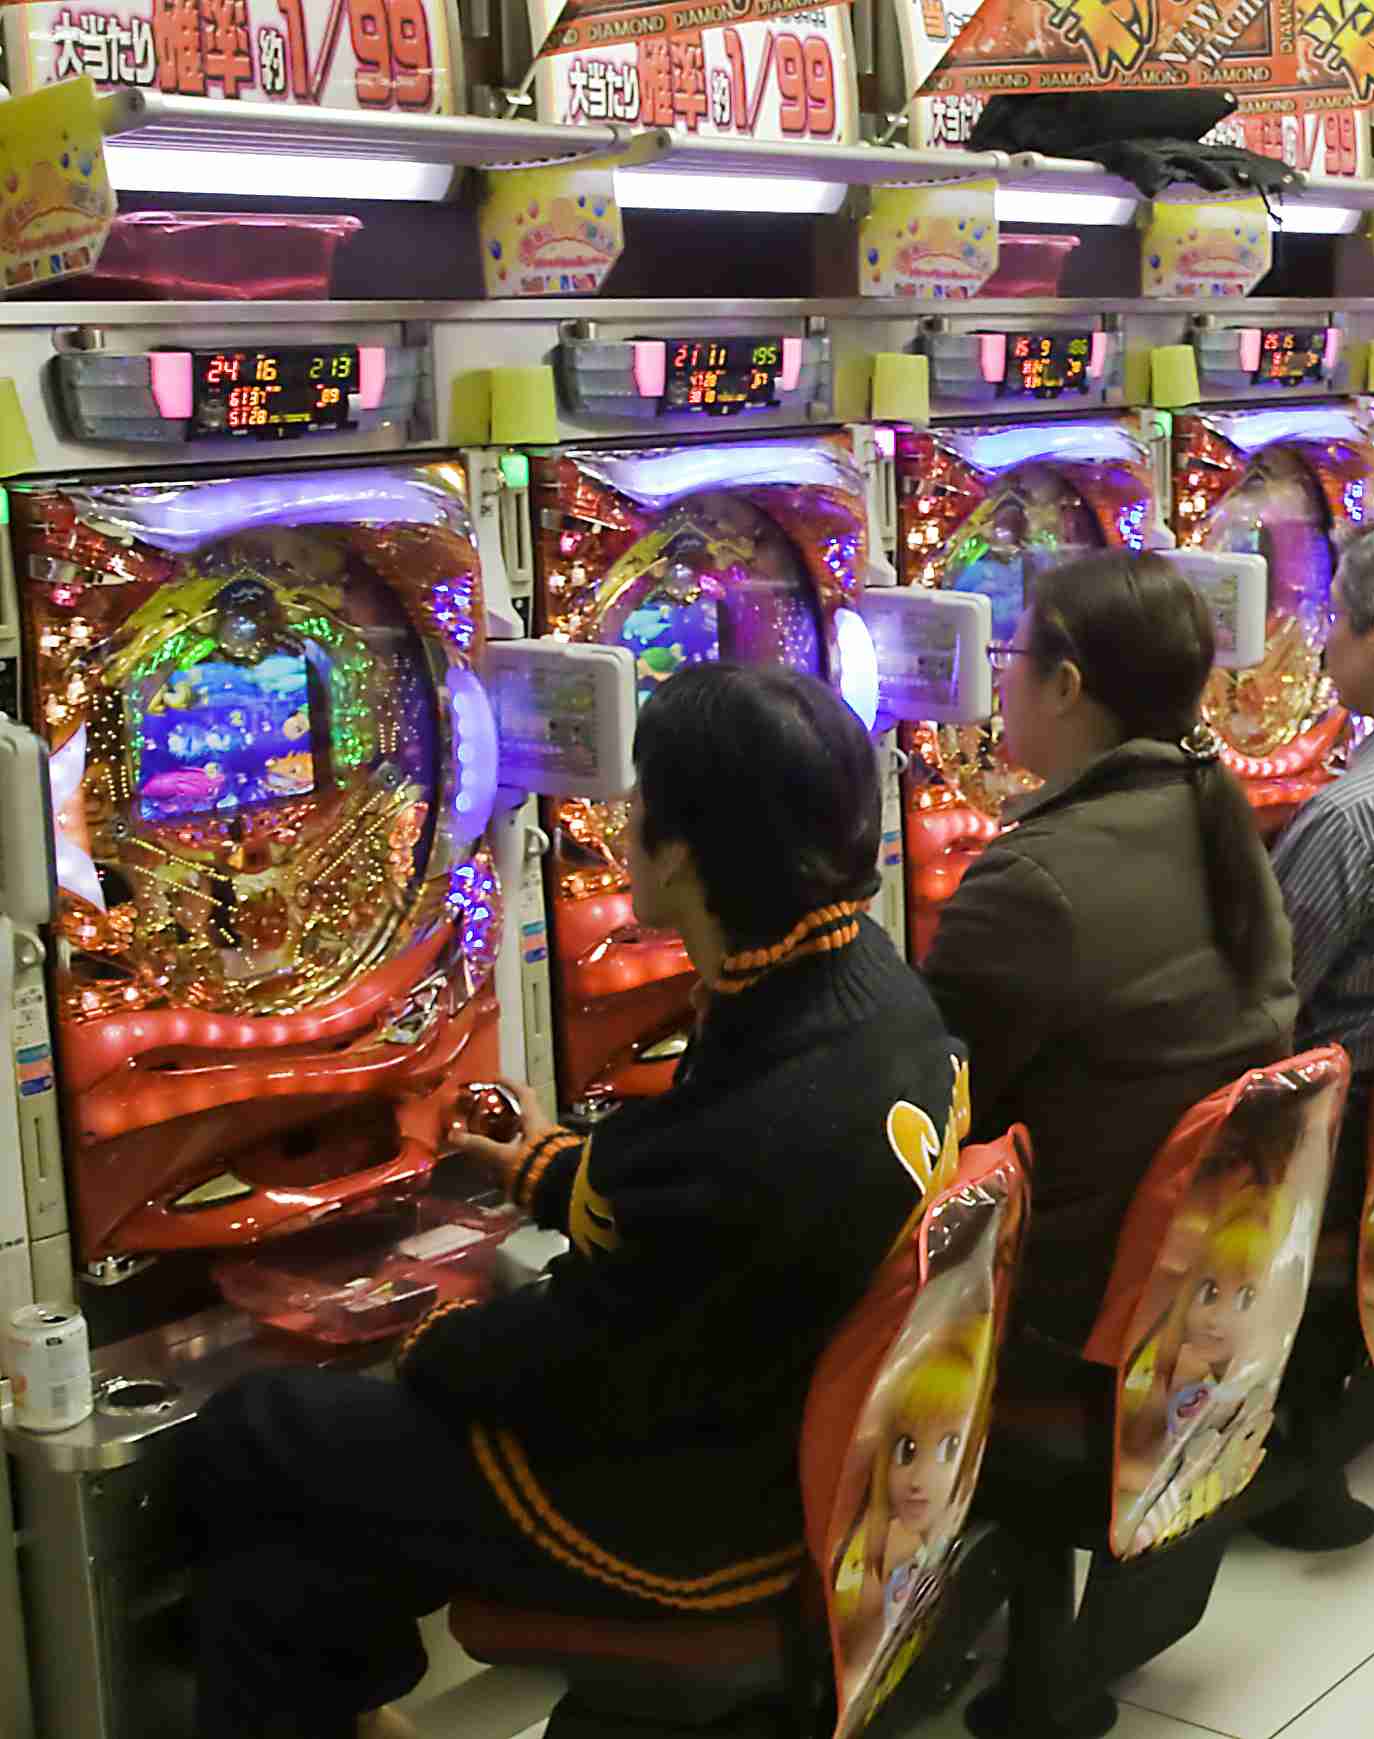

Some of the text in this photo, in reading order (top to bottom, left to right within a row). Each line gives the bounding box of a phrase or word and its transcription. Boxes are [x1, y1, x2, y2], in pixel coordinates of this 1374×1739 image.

[587, 16, 665, 41] DIAMOND
[1199, 66, 1271, 82] DIAMOND
[207, 357, 240, 384] 24
[255, 357, 277, 381] 16
